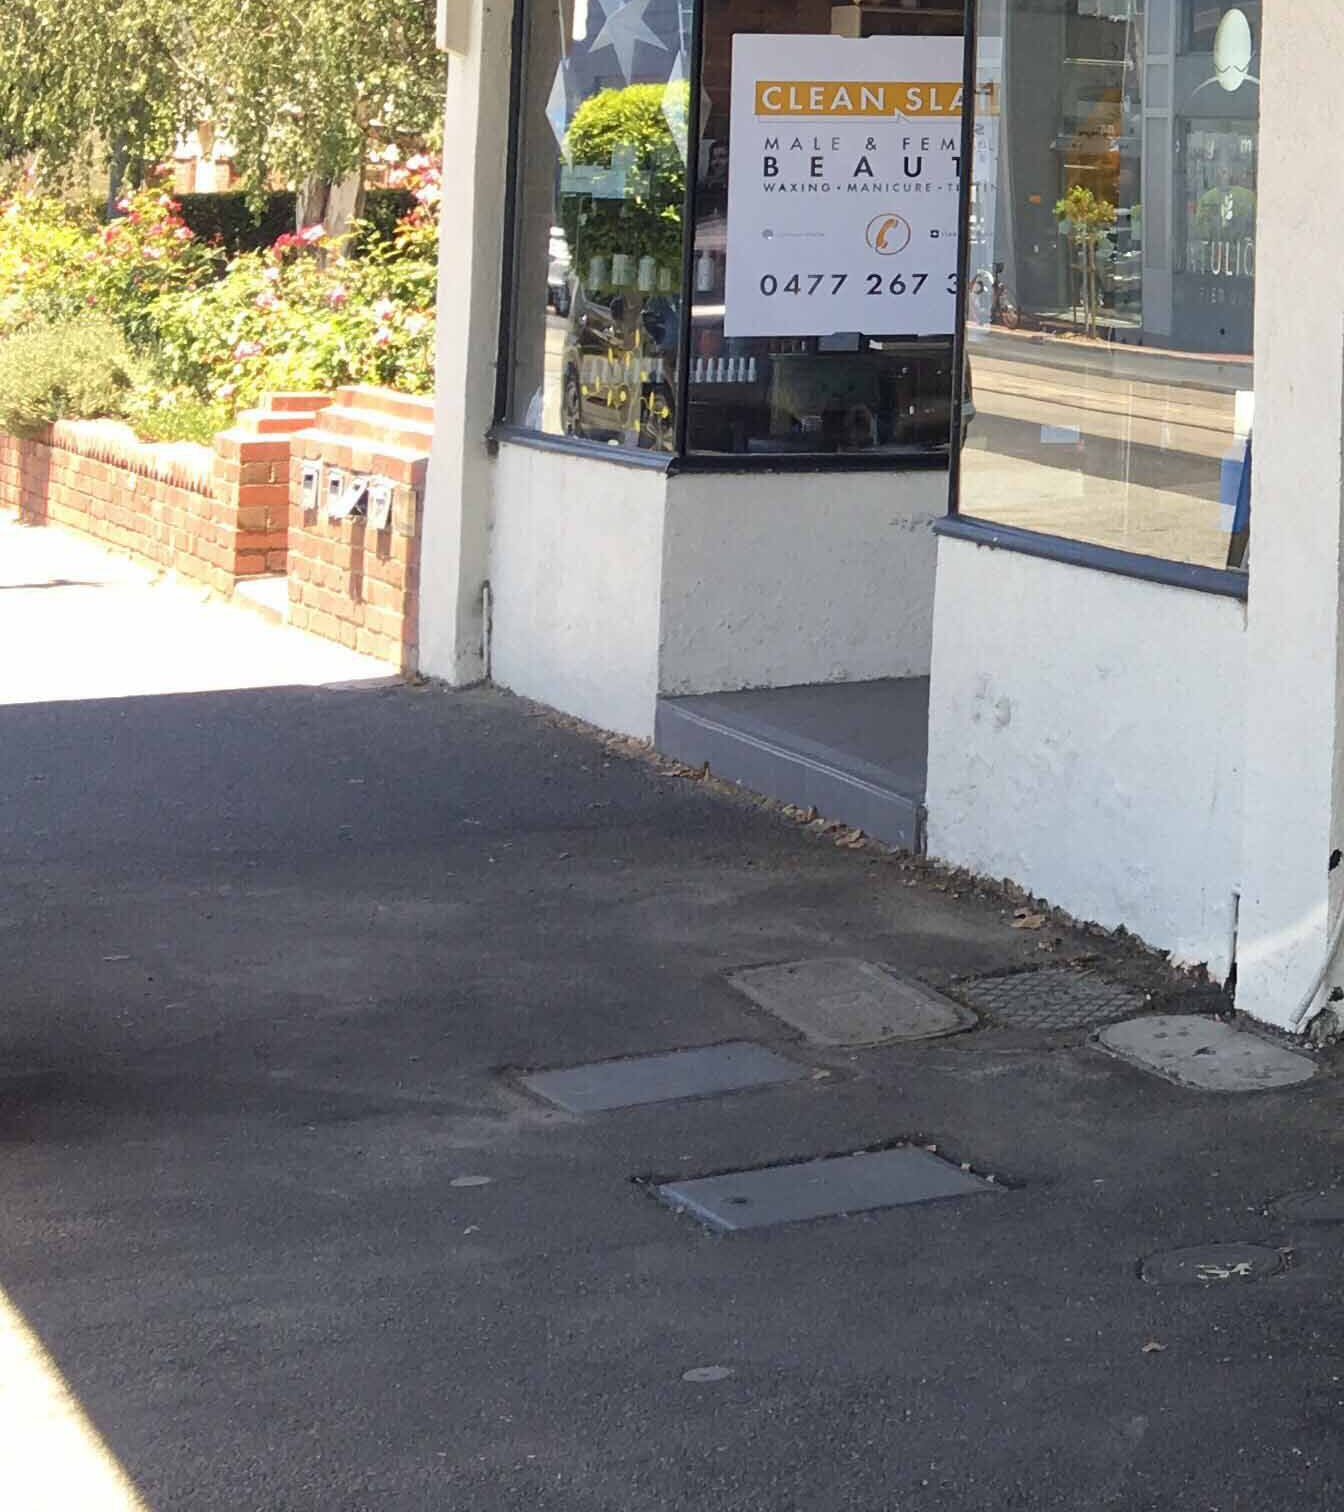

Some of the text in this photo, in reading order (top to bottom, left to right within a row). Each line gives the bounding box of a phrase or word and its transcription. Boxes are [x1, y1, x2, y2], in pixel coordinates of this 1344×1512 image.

[761, 85, 884, 112] CLEAN
[764, 137, 956, 152] MALE & FEM
[763, 183, 831, 193] WAXING
[846, 183, 931, 193] MANICURE
[760, 273, 848, 296] 0477
[866, 273, 929, 295] 267
